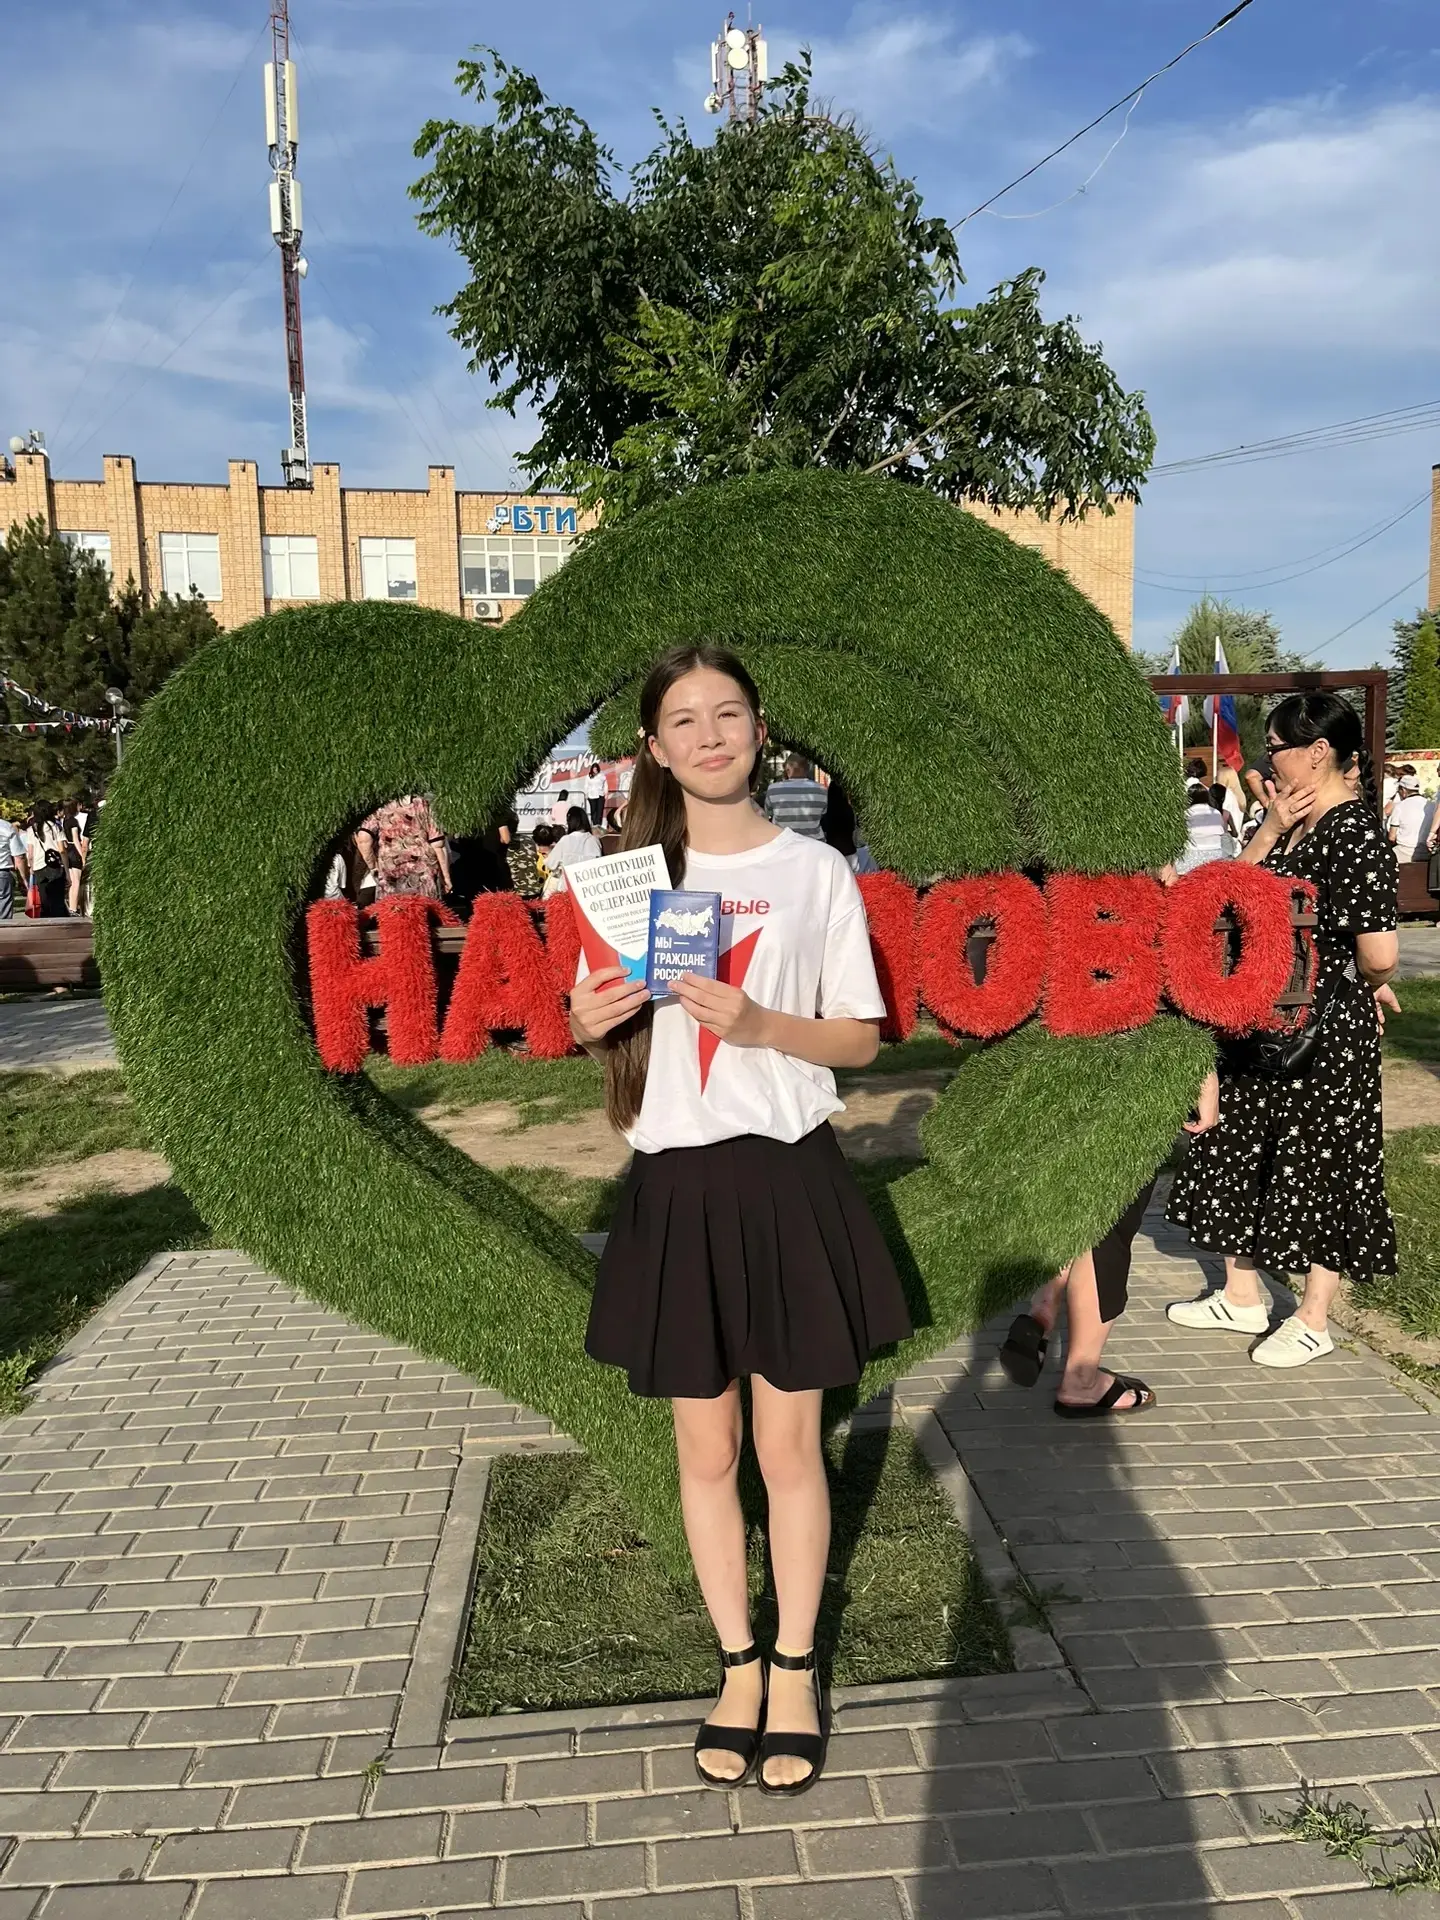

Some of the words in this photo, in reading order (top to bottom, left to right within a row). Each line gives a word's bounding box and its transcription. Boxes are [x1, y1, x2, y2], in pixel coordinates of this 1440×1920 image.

[512, 505, 577, 533] БТИ
[574, 854, 655, 883] КОНСТИТУЦИЯ
[582, 869, 656, 899] РОССИЙСКОЙ
[721, 900, 770, 915] вые
[655, 937, 672, 949] МЫ
[654, 952, 706, 967] ГРАЖДАНЕ
[653, 968, 693, 981] РОССИ
